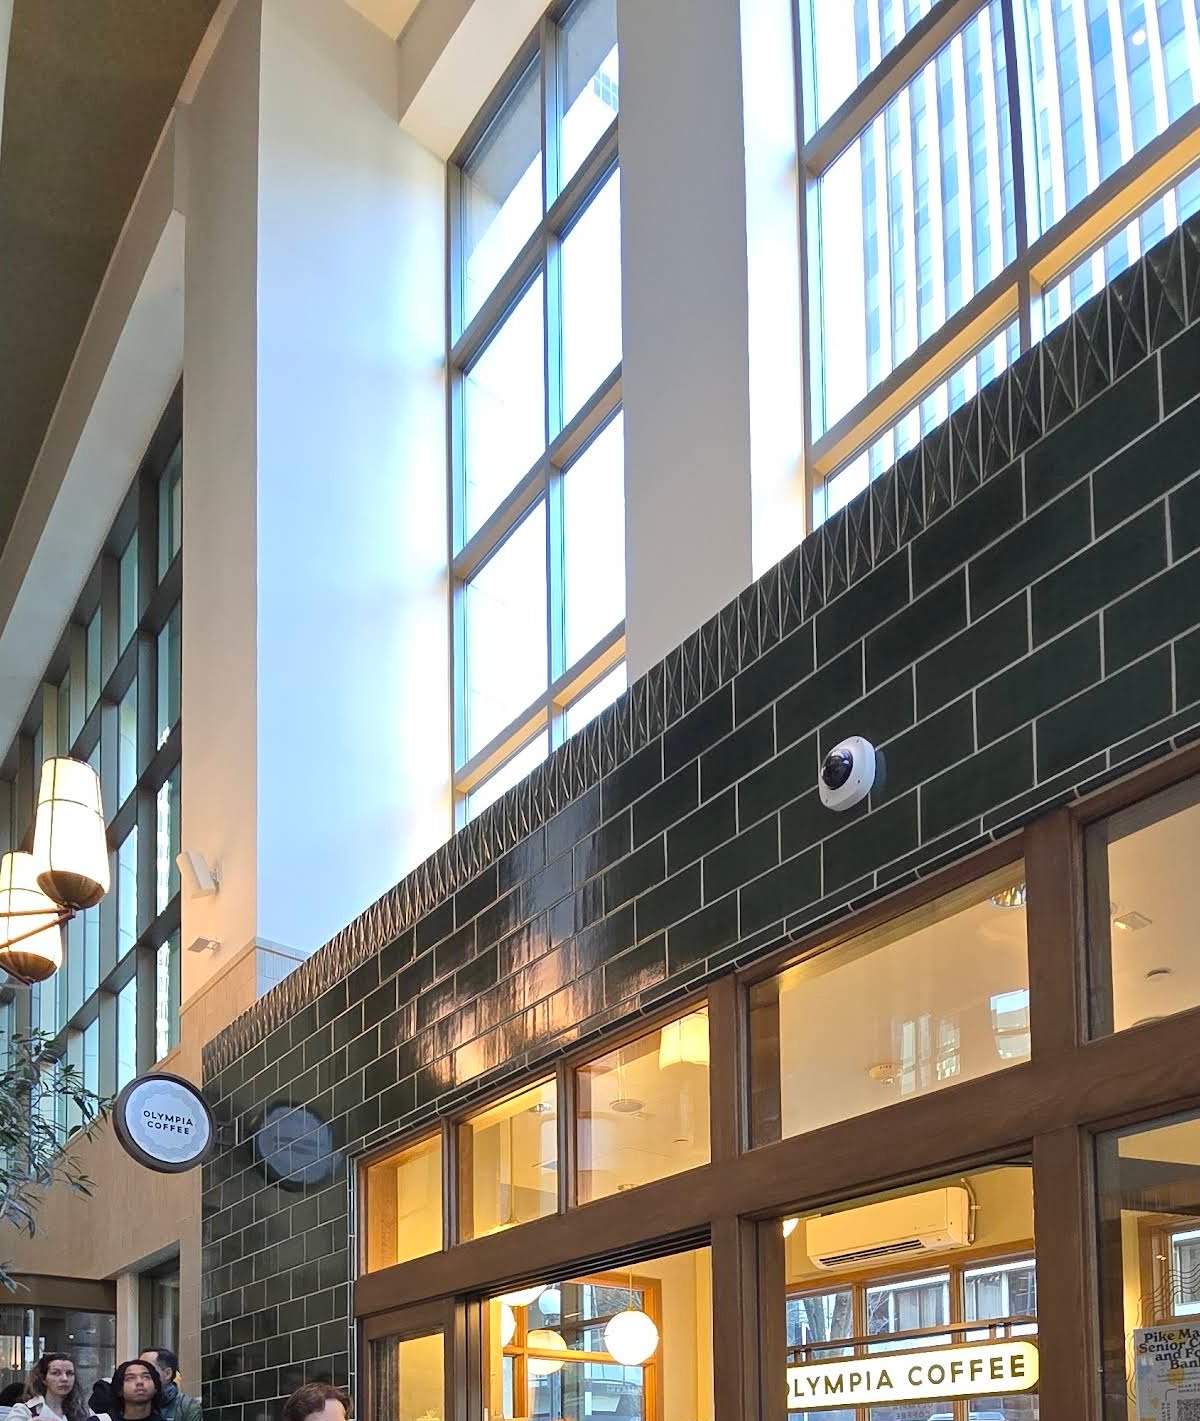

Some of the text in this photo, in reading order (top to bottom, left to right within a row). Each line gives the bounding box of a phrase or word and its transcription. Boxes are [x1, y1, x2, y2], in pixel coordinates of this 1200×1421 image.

[143, 1110, 193, 1126] OLYMPIA
[147, 1120, 190, 1135] COFFEE
[1144, 1331, 1175, 1343] Pike
[1138, 1337, 1200, 1354] Senior C
[1155, 1349, 1181, 1361] and
[1170, 1357, 1200, 1370] Ban
[787, 1354, 1025, 1397] LYMPIA COFFEE
